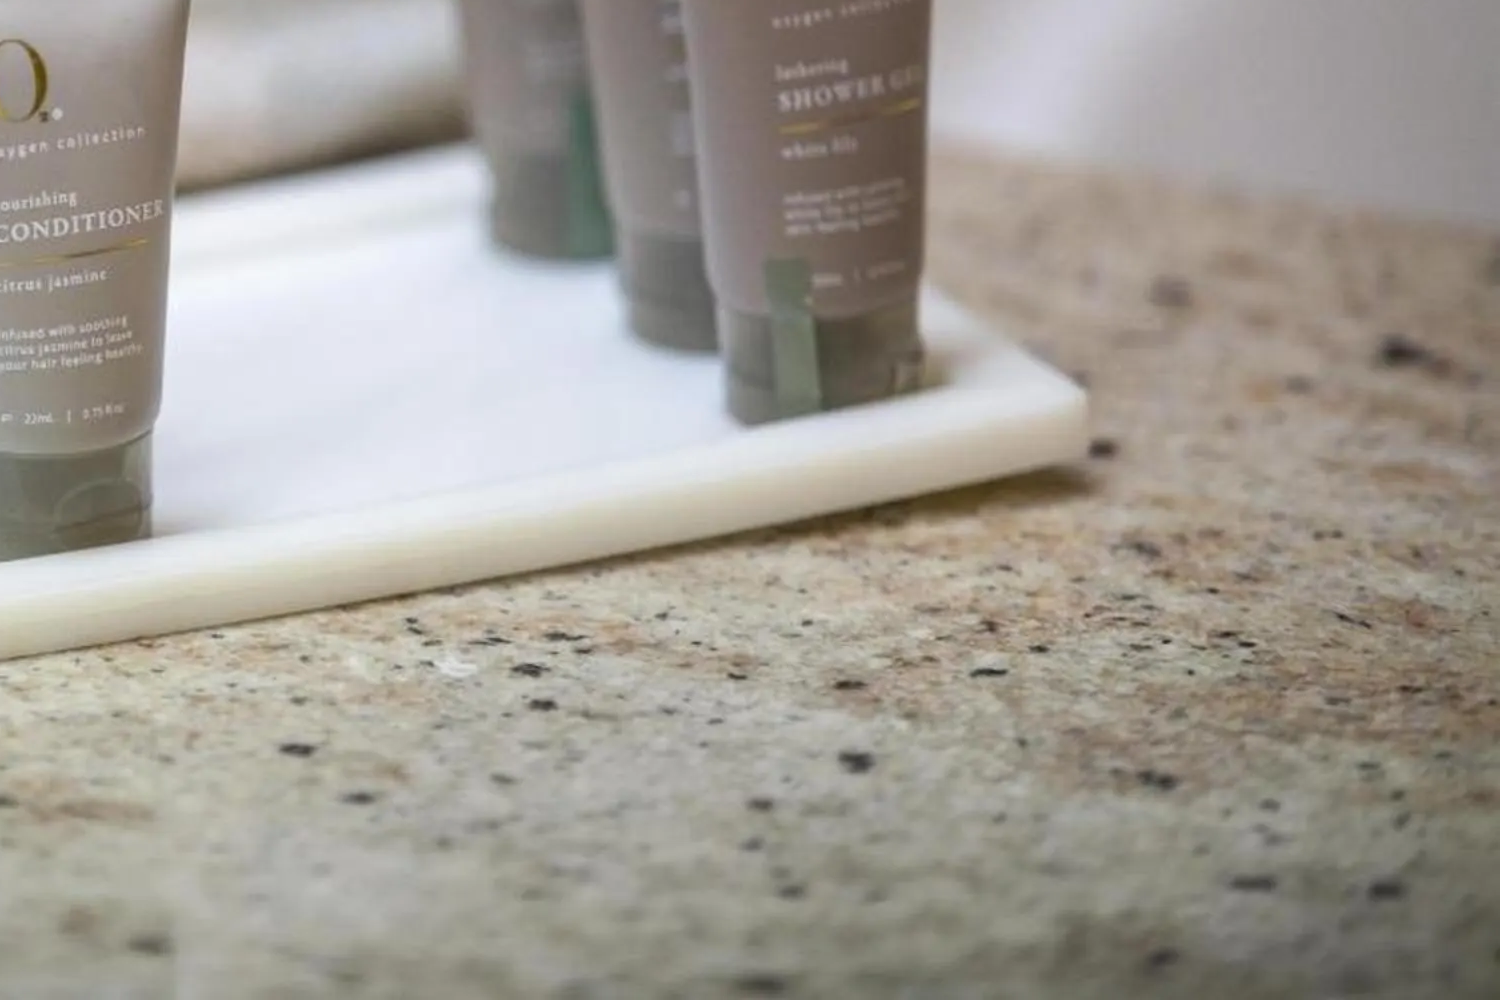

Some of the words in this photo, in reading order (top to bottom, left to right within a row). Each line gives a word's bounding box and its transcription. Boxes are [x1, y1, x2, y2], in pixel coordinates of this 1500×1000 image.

[777, 73, 885, 112] SHOWER
[56, 126, 146, 150] collection
[48, 268, 109, 293] jasmine
[48, 323, 76, 338] with
[79, 315, 129, 334] soothing
[38, 340, 89, 358] jasmine
[91, 336, 104, 348] to
[30, 358, 58, 371] hair
[60, 353, 104, 370] feeling
